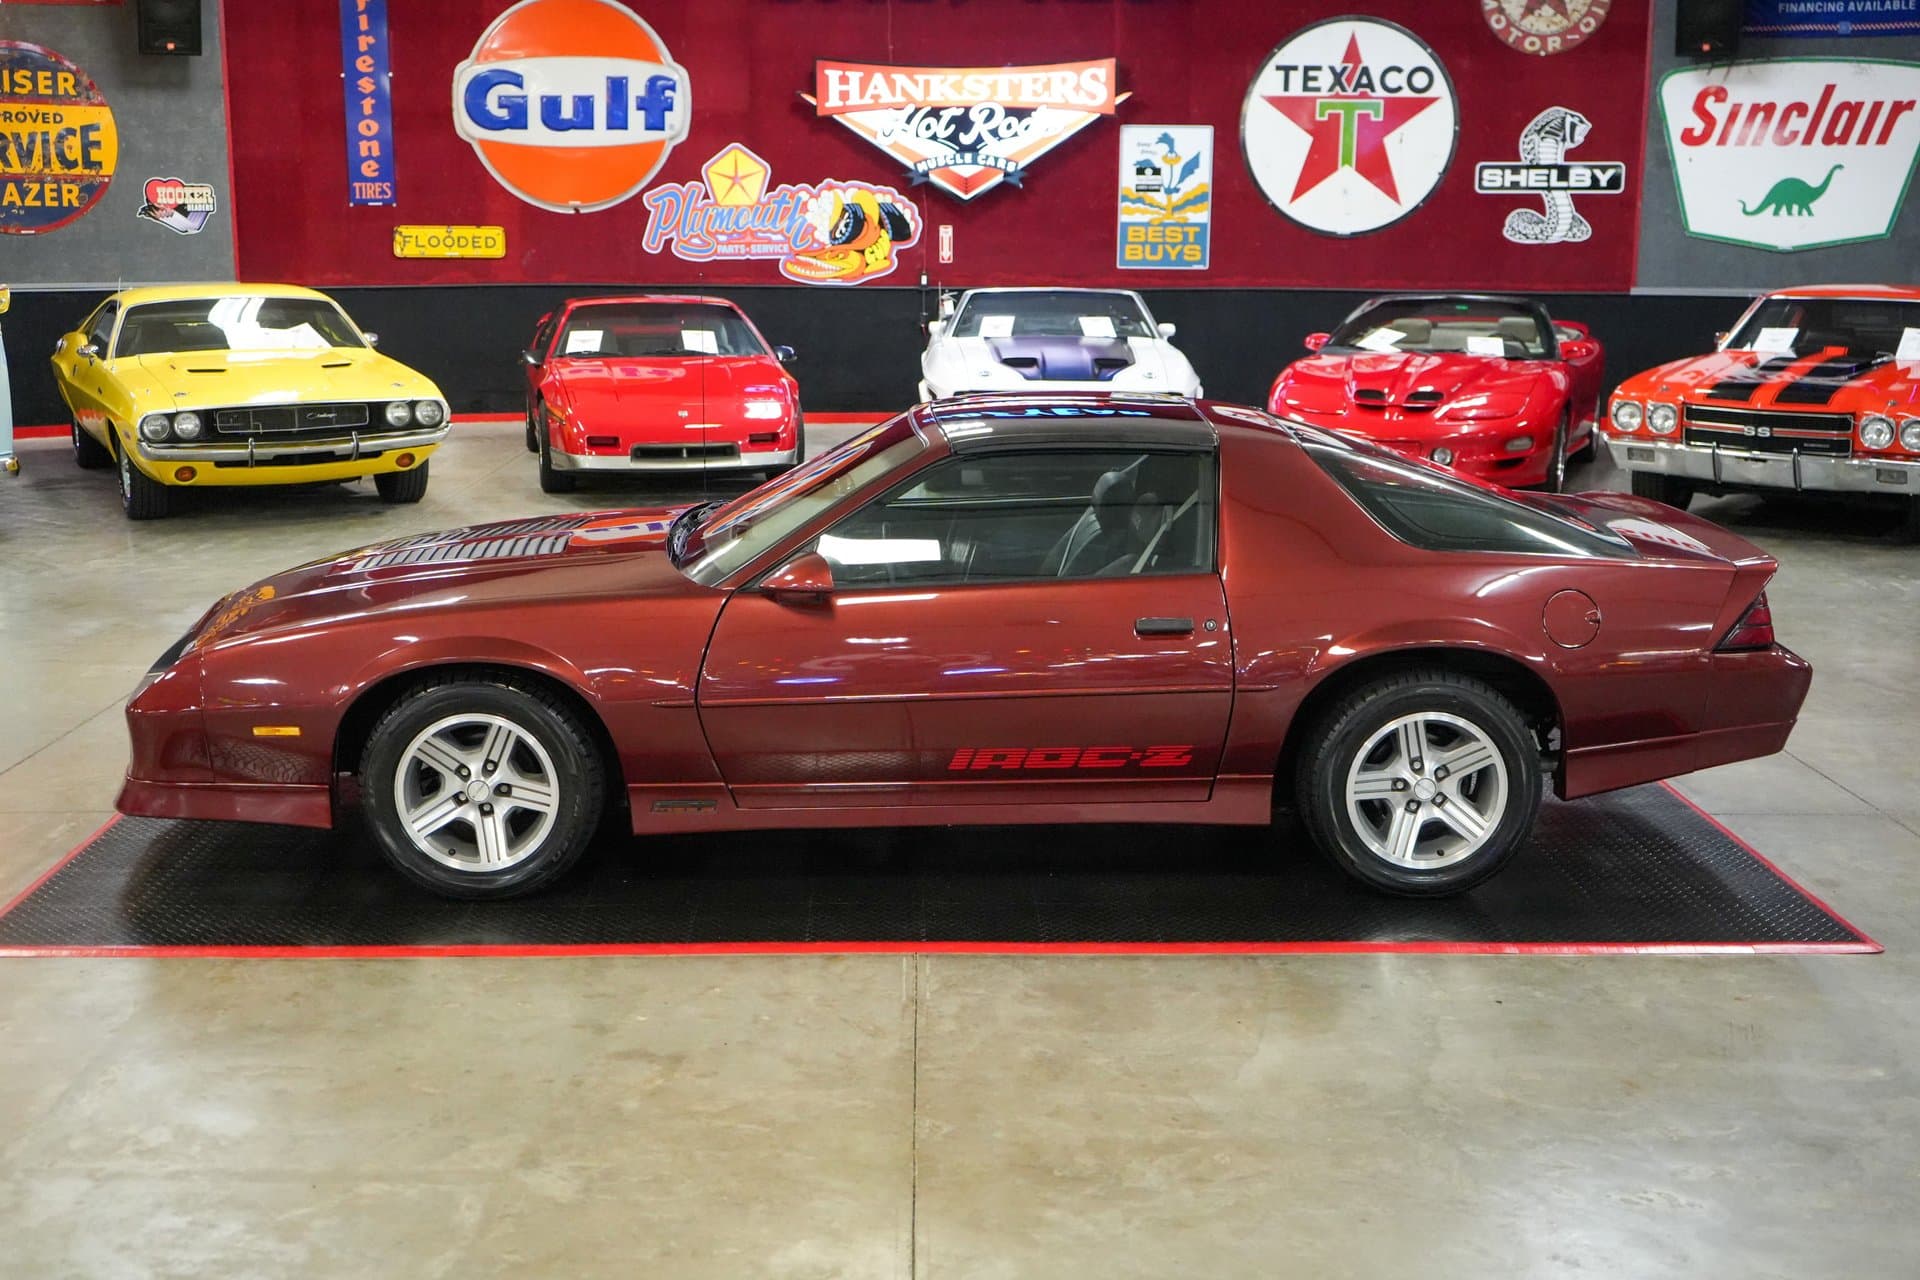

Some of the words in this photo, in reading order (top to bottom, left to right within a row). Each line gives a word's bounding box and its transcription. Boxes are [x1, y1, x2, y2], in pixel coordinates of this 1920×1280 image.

[1778, 3, 1844, 13] FINANCING
[1850, 0, 1916, 11] AVAILABLE
[824, 66, 1109, 108] HANKSTERS
[1275, 65, 1435, 94] TEXACO
[464, 69, 677, 132] Gulf
[0, 111, 64, 124] ROVED
[875, 102, 966, 146] Hot
[1680, 84, 1917, 147] Sinclair
[1316, 100, 1383, 168] T
[916, 152, 972, 173] MUSCLE
[977, 152, 1017, 173] CARS
[1481, 168, 1619, 190] SHELBY
[353, 182, 392, 200] TIRES
[651, 188, 812, 254] Plymouth
[402, 235, 497, 249] FLOODED
[1127, 226, 1201, 243] BEST
[1125, 244, 1202, 262] BUYS
[1743, 425, 1771, 437] SS
